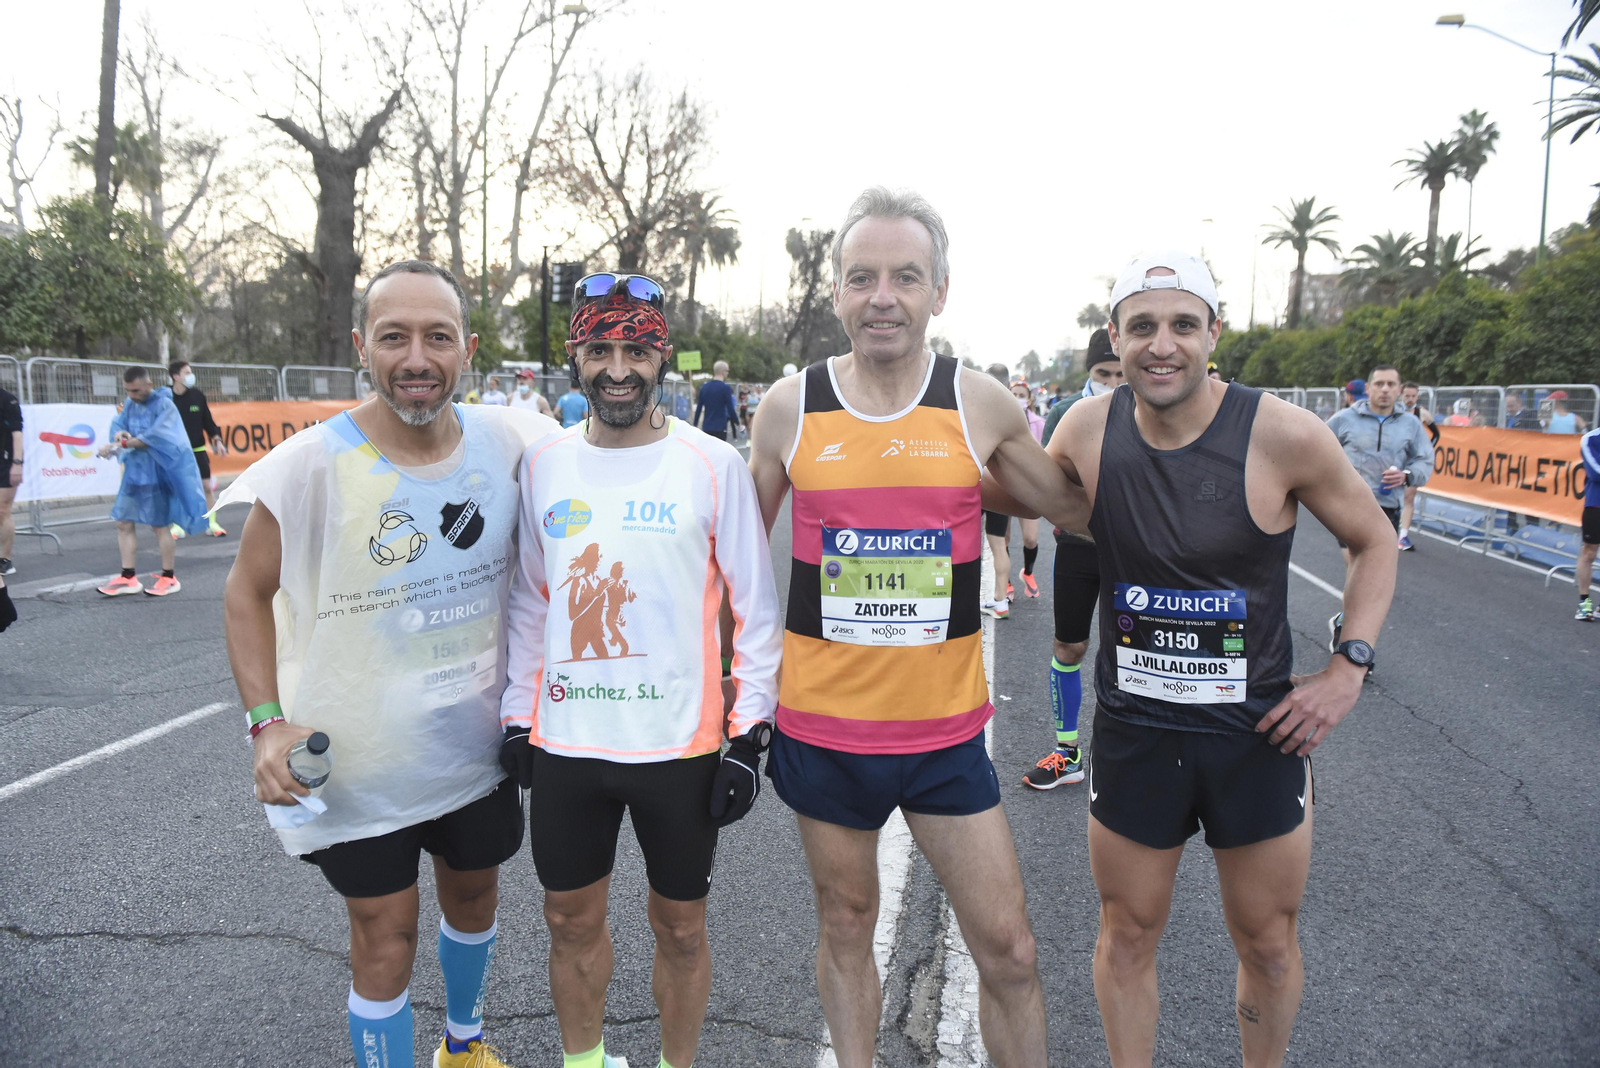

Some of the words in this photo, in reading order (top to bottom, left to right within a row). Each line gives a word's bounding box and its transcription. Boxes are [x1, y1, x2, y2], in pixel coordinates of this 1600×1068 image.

[909, 439, 948, 447] Atletica
[909, 449, 919, 457] LA
[920, 450, 949, 458] SBARRA
[623, 499, 678, 525] 10K
[447, 501, 477, 542] SPARTA
[622, 524, 677, 535] mercamadrid
[863, 535, 936, 551] ZURICH
[328, 591, 362, 604] This
[367, 587, 396, 598] rain
[400, 577, 439, 592] cover
[443, 571, 454, 581] is
[458, 562, 491, 579] made
[864, 573, 905, 590] 1141
[350, 598, 400, 613] starch
[403, 588, 442, 603] which
[446, 583, 457, 594] is
[1153, 594, 1229, 612] ZURICH
[428, 598, 490, 625] ZURICH
[854, 602, 918, 617] ZATOPEK
[1154, 629, 1199, 650] 3150
[1131, 654, 1228, 675] J.VILLALOBOS
[637, 684, 664, 700] S.L.
